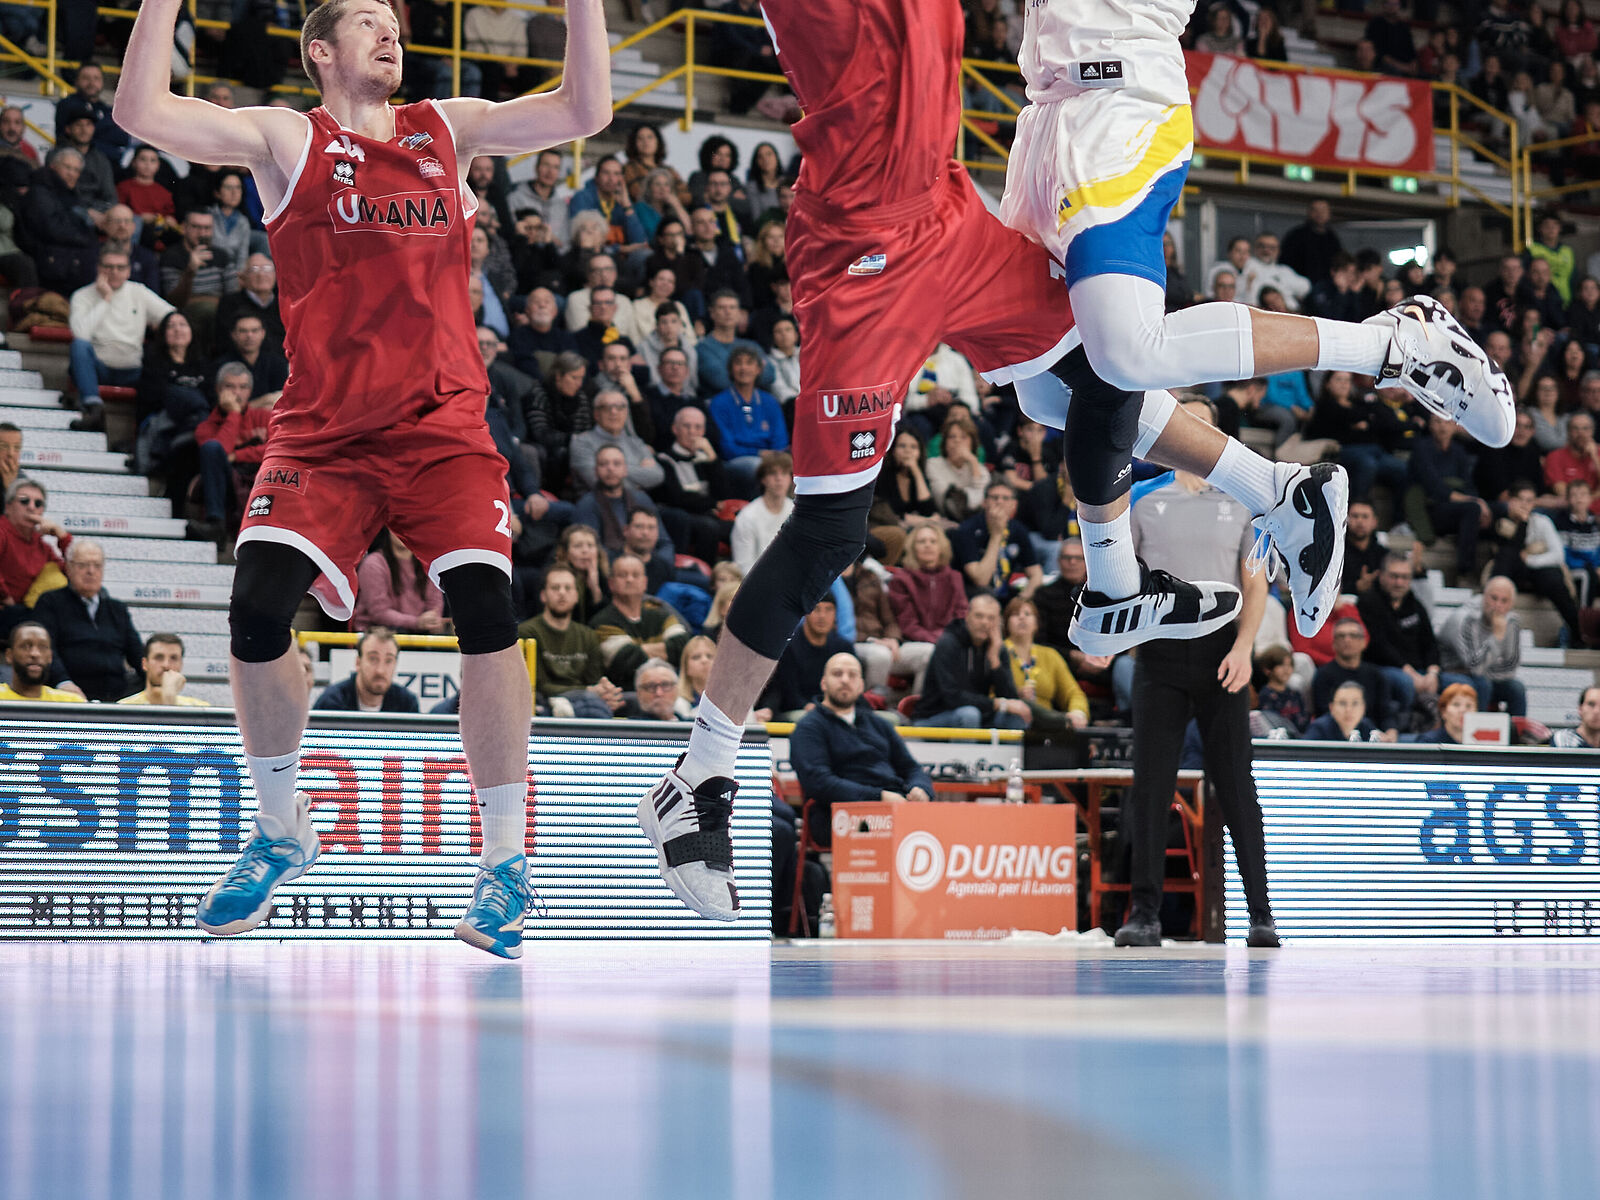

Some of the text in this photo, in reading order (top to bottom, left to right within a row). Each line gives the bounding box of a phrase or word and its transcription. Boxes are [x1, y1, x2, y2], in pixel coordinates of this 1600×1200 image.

[337, 194, 450, 229] UMANA
[262, 469, 300, 488] ANA
[945, 843, 1075, 879] DURING
[946, 880, 998, 899] Agenzia
[998, 883, 1020, 899] per
[1031, 880, 1075, 896] Lavoro
